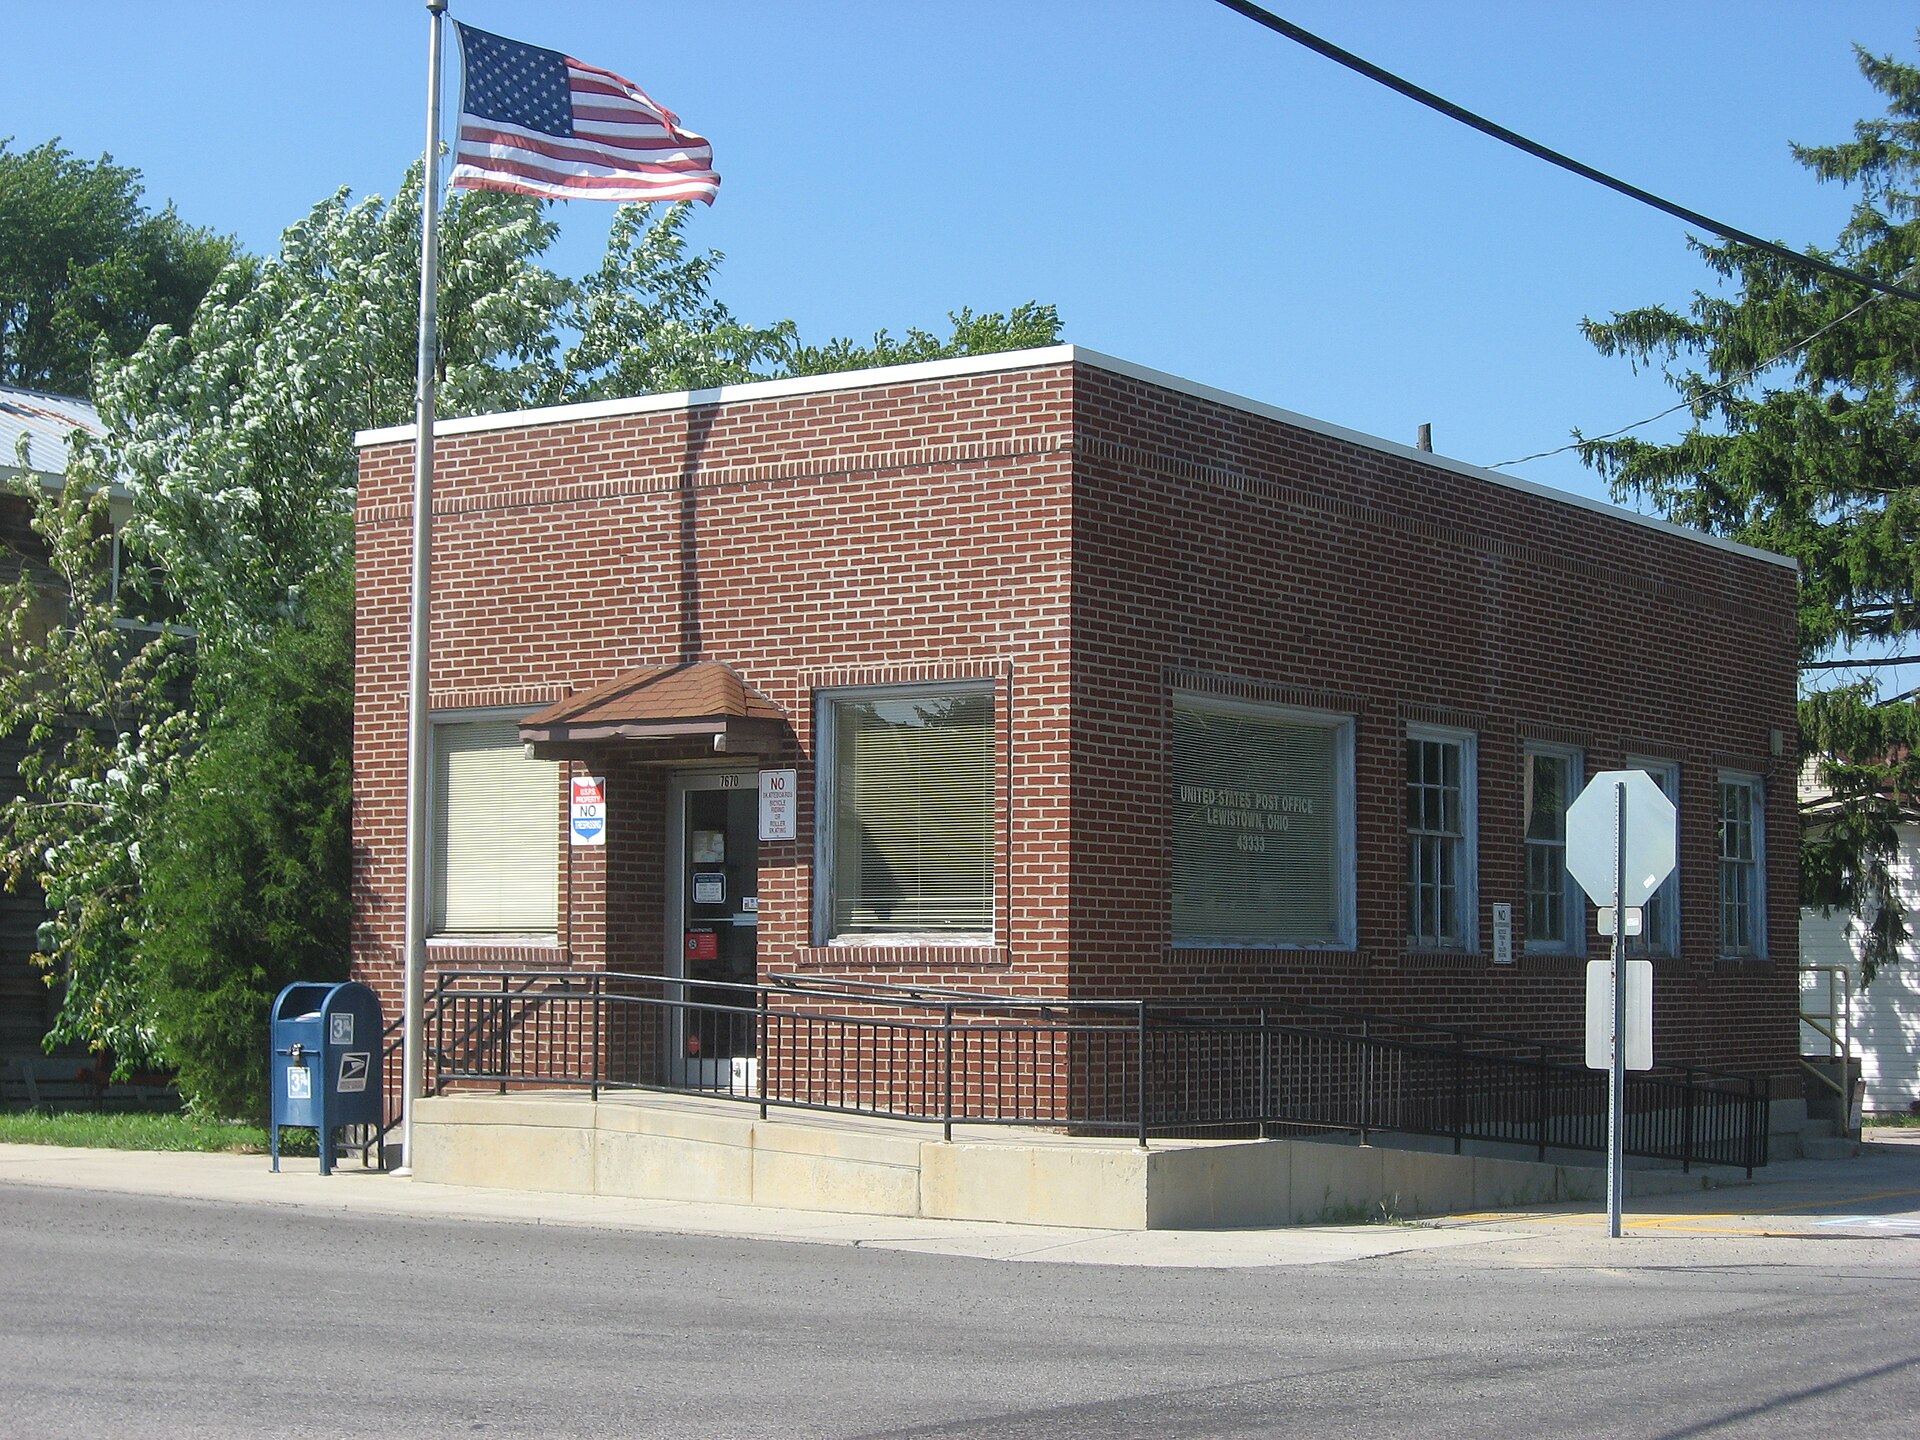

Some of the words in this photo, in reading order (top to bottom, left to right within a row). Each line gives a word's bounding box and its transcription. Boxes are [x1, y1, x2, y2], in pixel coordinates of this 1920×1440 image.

[720, 775, 739, 787] 7670
[771, 778, 784, 790] NO
[1180, 785, 1215, 804] UNITED
[1218, 789, 1251, 808] STATES
[1255, 792, 1278, 811] POST
[1282, 796, 1313, 814] OFFICE
[580, 805, 596, 817] NO
[1207, 808, 1264, 831] LEWISTOWN,
[1267, 814, 1289, 831] OHIO
[1237, 835, 1265, 851] 43333
[334, 1020, 342, 1037] 3
[292, 1074, 300, 1091] 3
